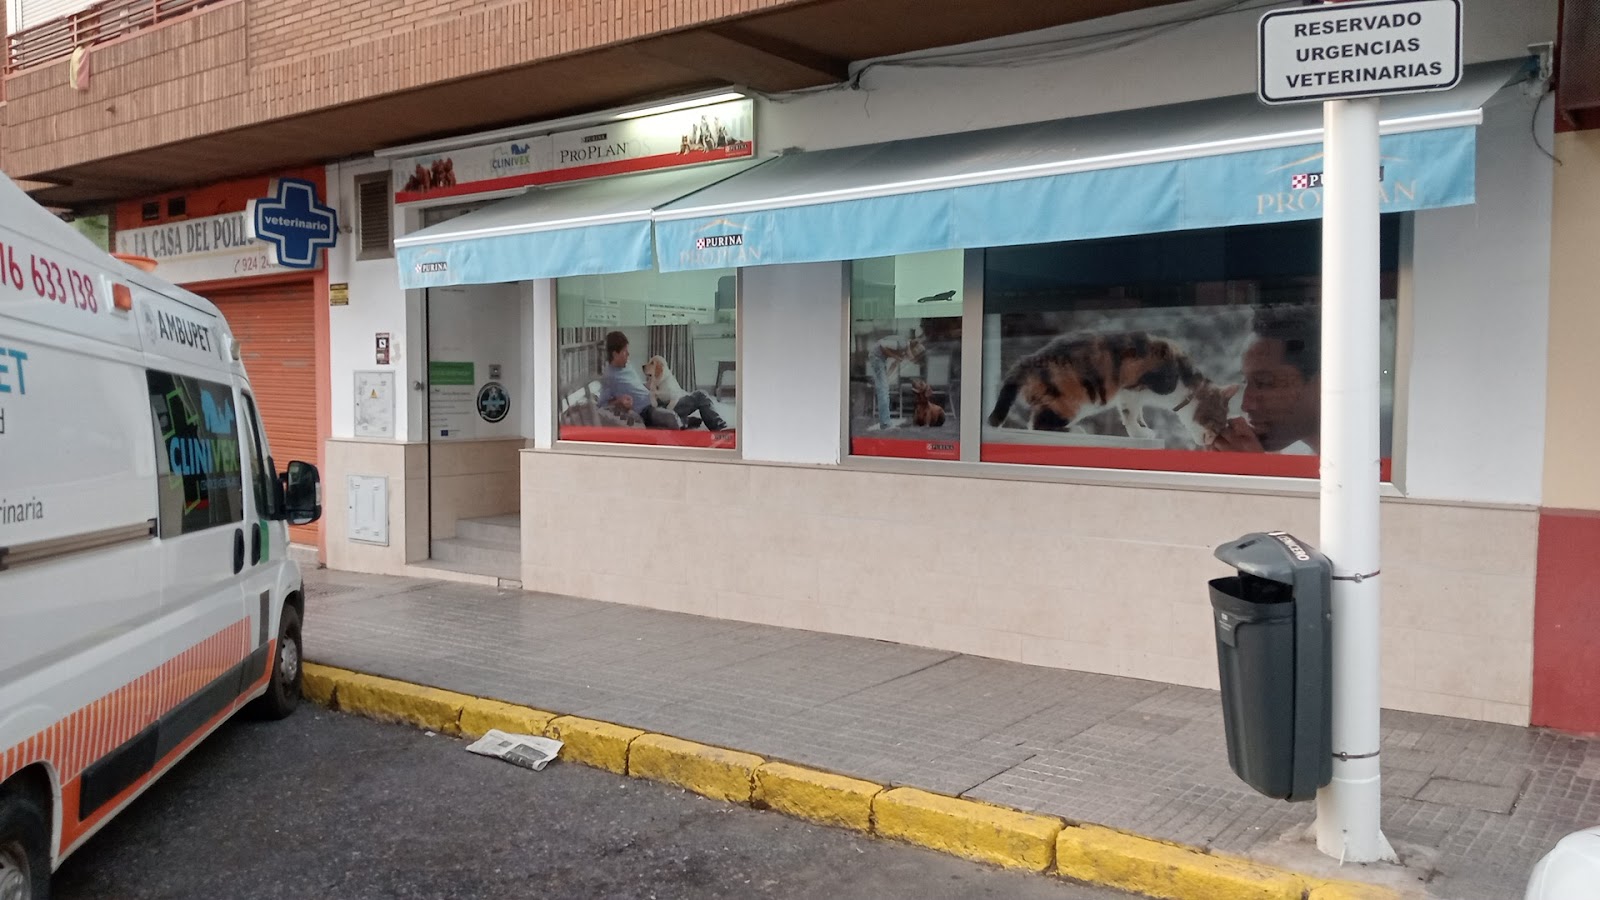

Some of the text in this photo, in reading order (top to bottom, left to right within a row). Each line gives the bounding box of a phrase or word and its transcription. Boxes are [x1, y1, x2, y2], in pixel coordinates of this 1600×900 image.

[1294, 11, 1422, 38] RESERVADO
[1296, 38, 1421, 62] URGENCIAS
[1286, 61, 1442, 89] VETERINARIAS
[492, 155, 530, 169] CLINIVEX
[264, 214, 328, 232] veterinario
[134, 214, 254, 258] LA CASA DEL POLL
[705, 235, 743, 248] PURINA
[242, 256, 258, 271] 924
[421, 262, 448, 273] PURINA
[31, 254, 67, 304] 633
[67, 268, 98, 313] 138
[158, 310, 212, 352] AMBUPET
[170, 436, 240, 476] CLINIVEX
